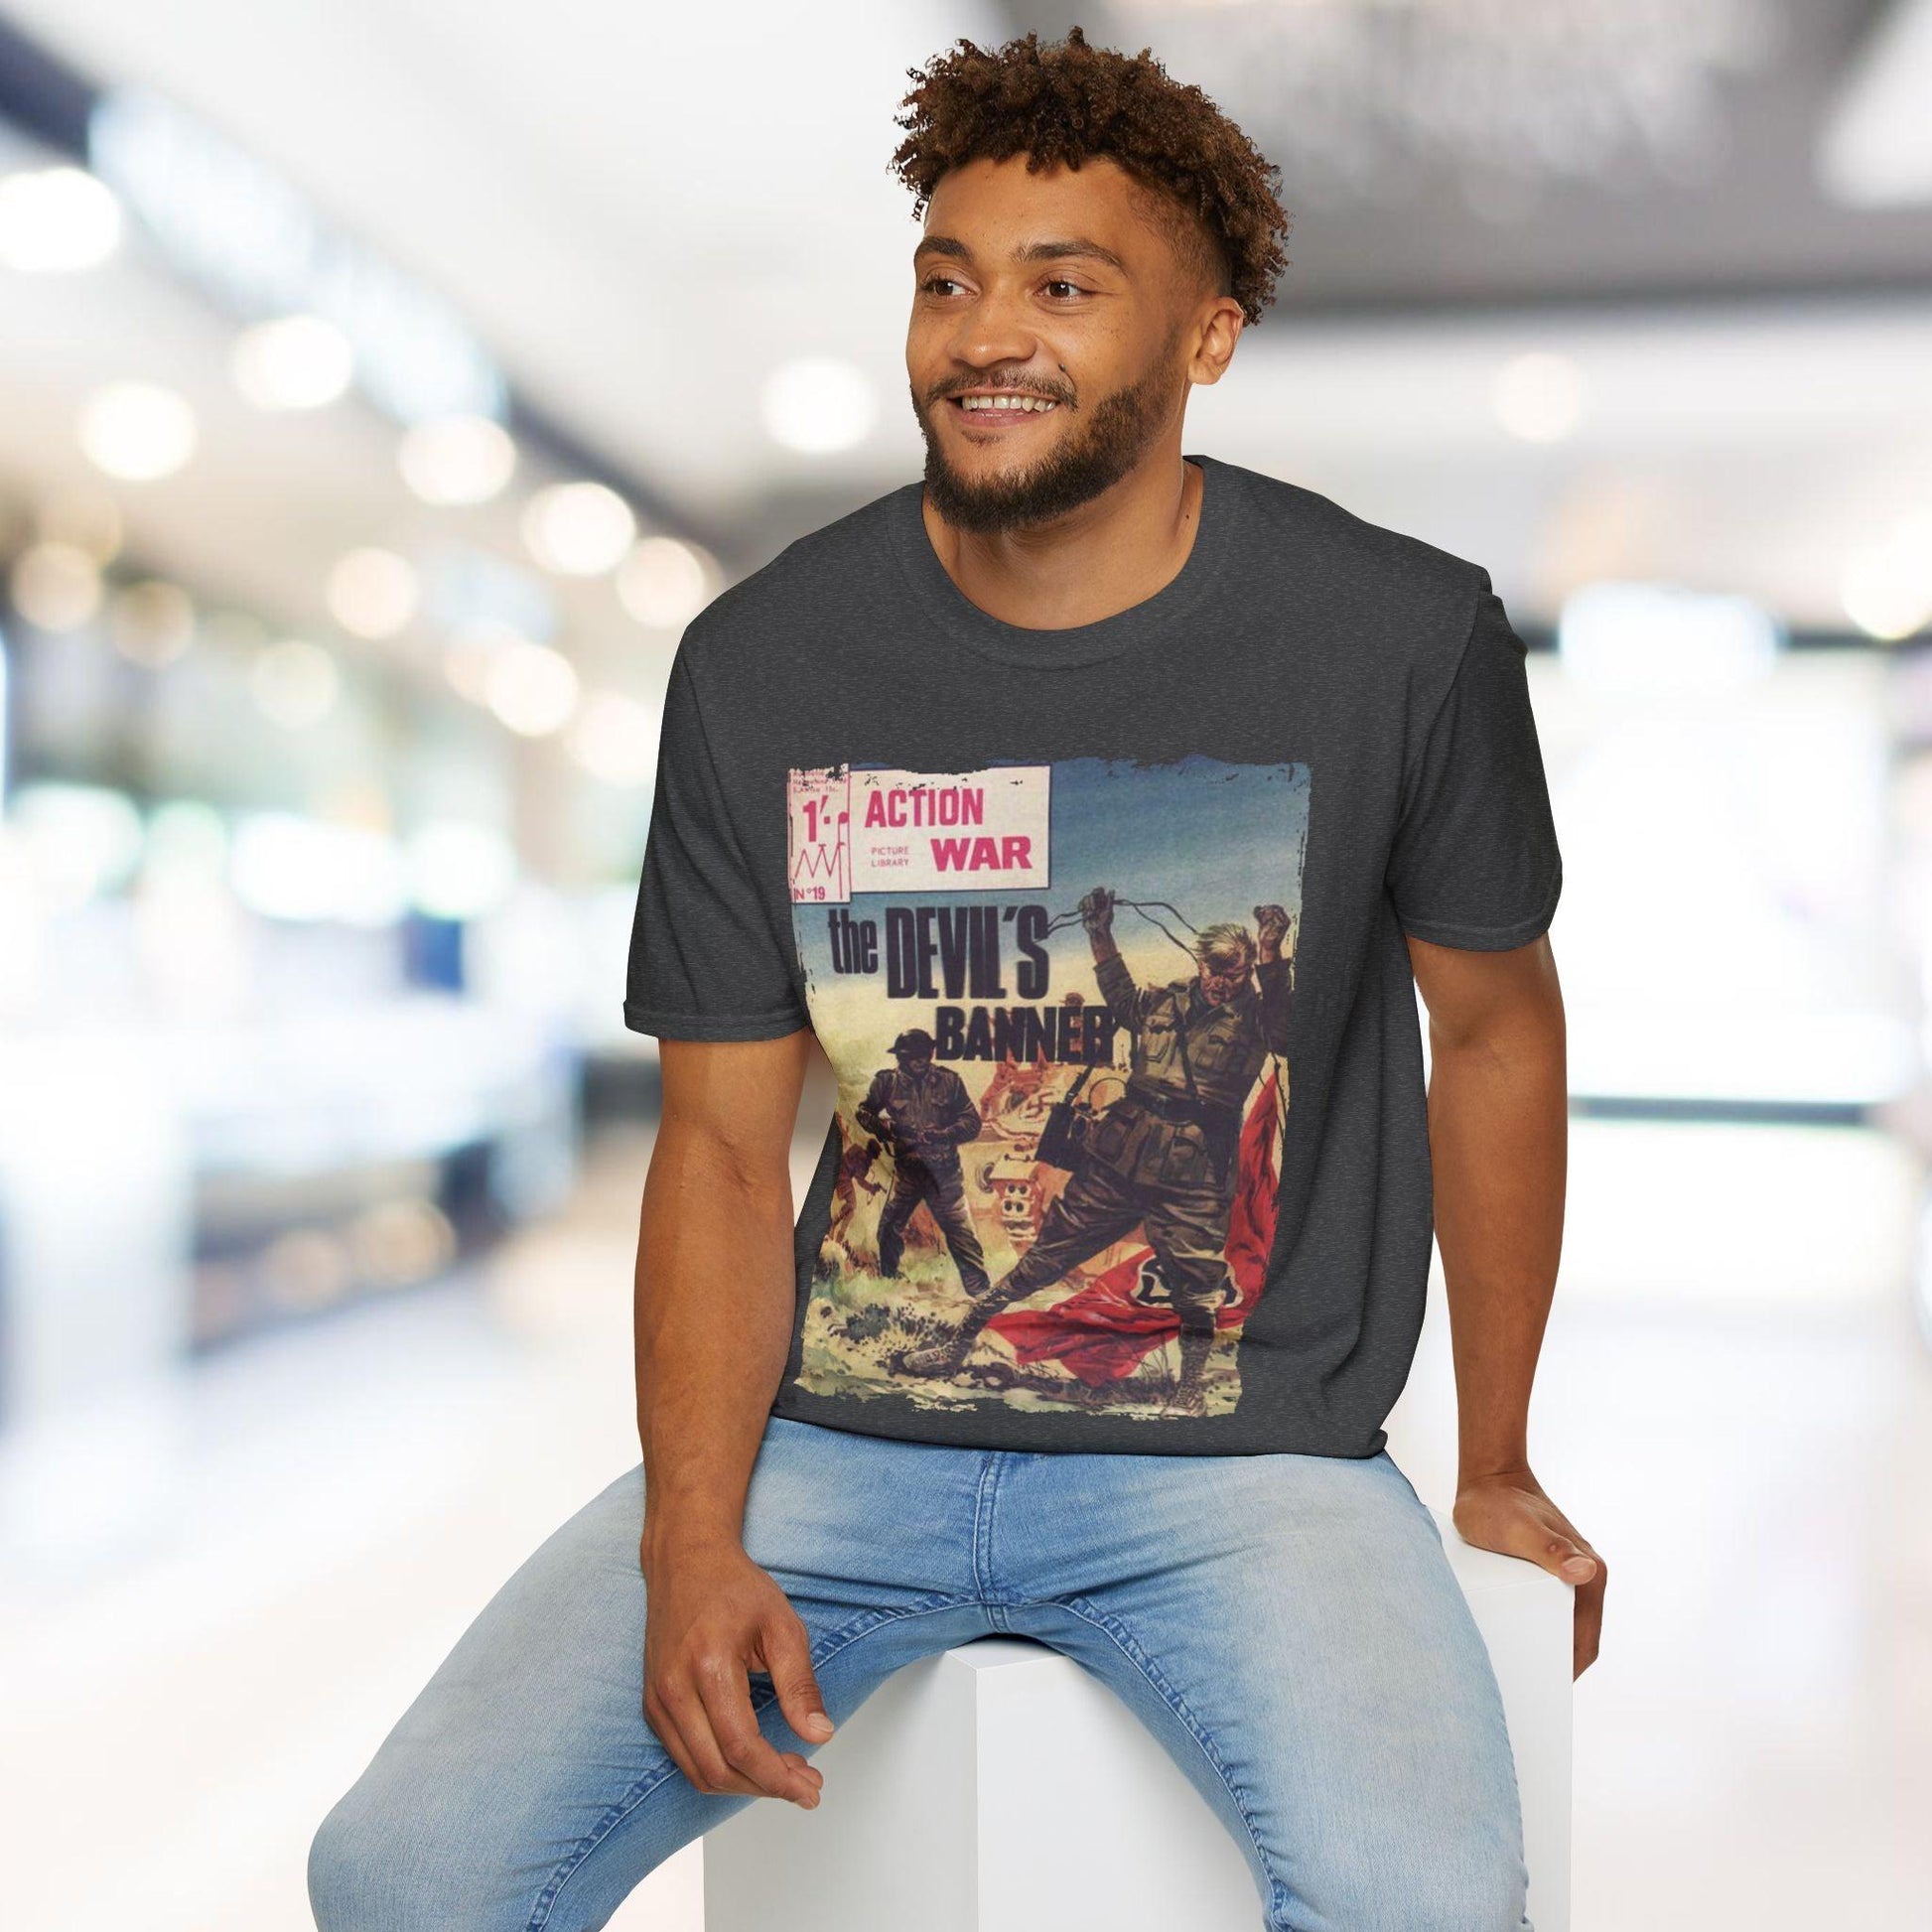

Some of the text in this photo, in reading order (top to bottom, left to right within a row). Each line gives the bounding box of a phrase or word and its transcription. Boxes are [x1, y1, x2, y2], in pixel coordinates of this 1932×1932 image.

[865, 788, 984, 828] ACTION
[871, 846, 909, 856] PICTURE
[871, 858, 909, 868] LIBRARY
[930, 836, 1033, 872] WAR
[828, 904, 1049, 999] the DEVIL'S
[935, 1005, 1114, 1062] BANNER
